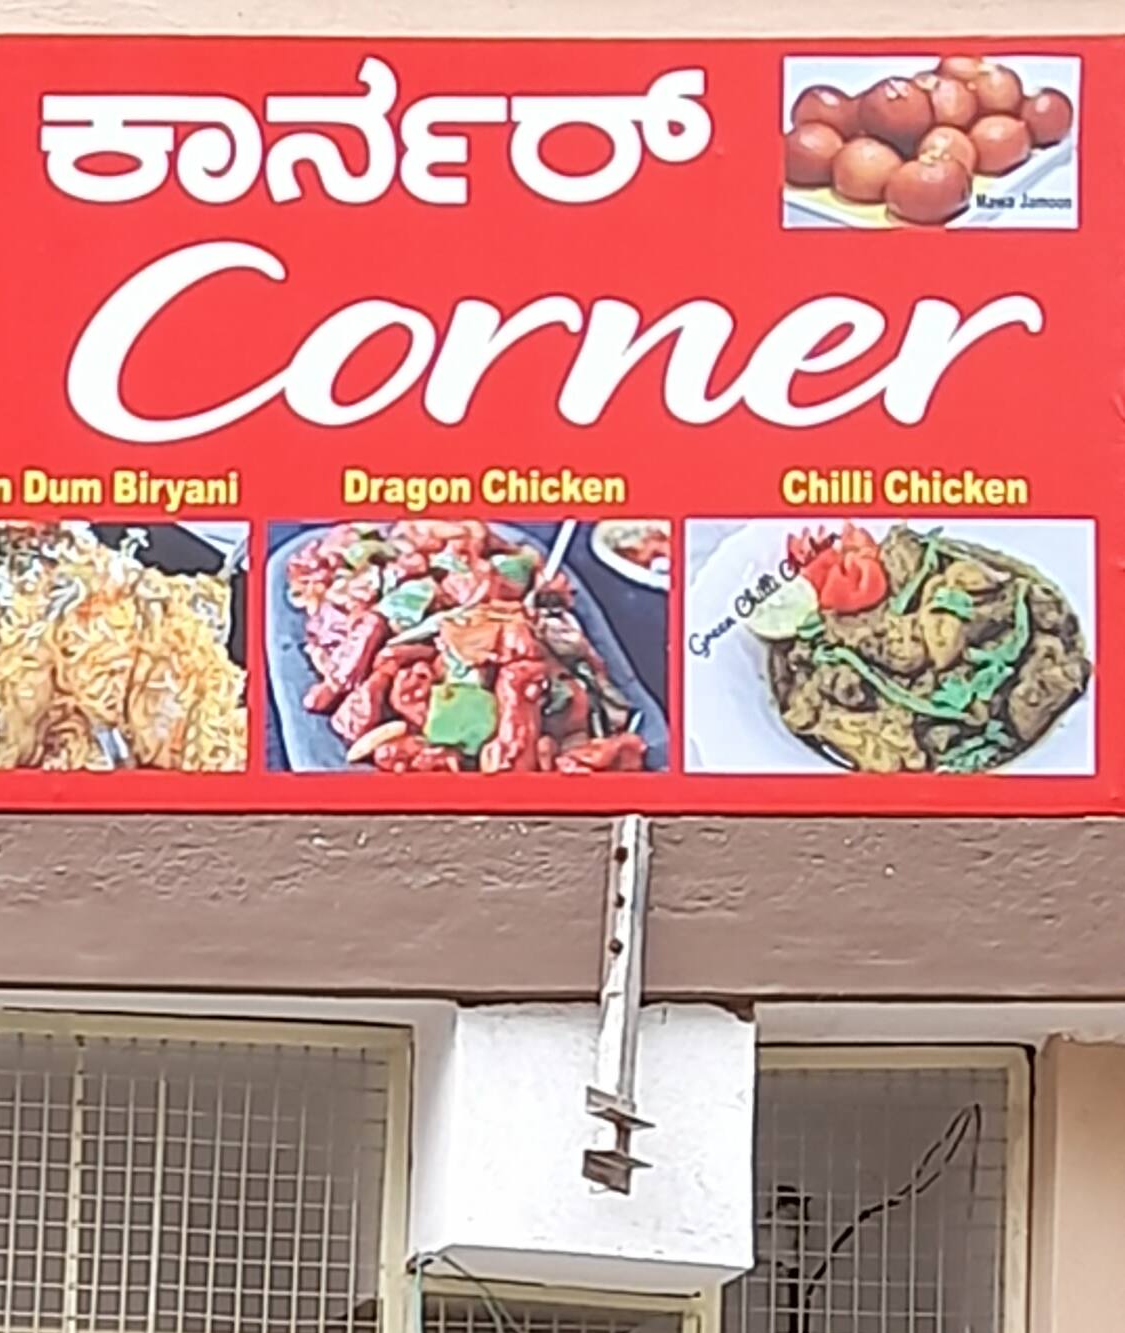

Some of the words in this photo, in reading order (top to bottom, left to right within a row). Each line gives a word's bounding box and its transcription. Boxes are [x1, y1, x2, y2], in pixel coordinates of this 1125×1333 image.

[41, 57, 711, 204] ಕಾರ್ನರ್
[67, 242, 1043, 443] Corner
[23, 470, 102, 504] Dum
[113, 470, 238, 512] Biryani
[344, 469, 471, 512] Dragon
[482, 469, 625, 503] Chicken
[782, 470, 873, 504] Chilli
[884, 470, 1028, 505] Chicken
[689, 616, 736, 658] Green
[735, 574, 781, 618] Chilli
